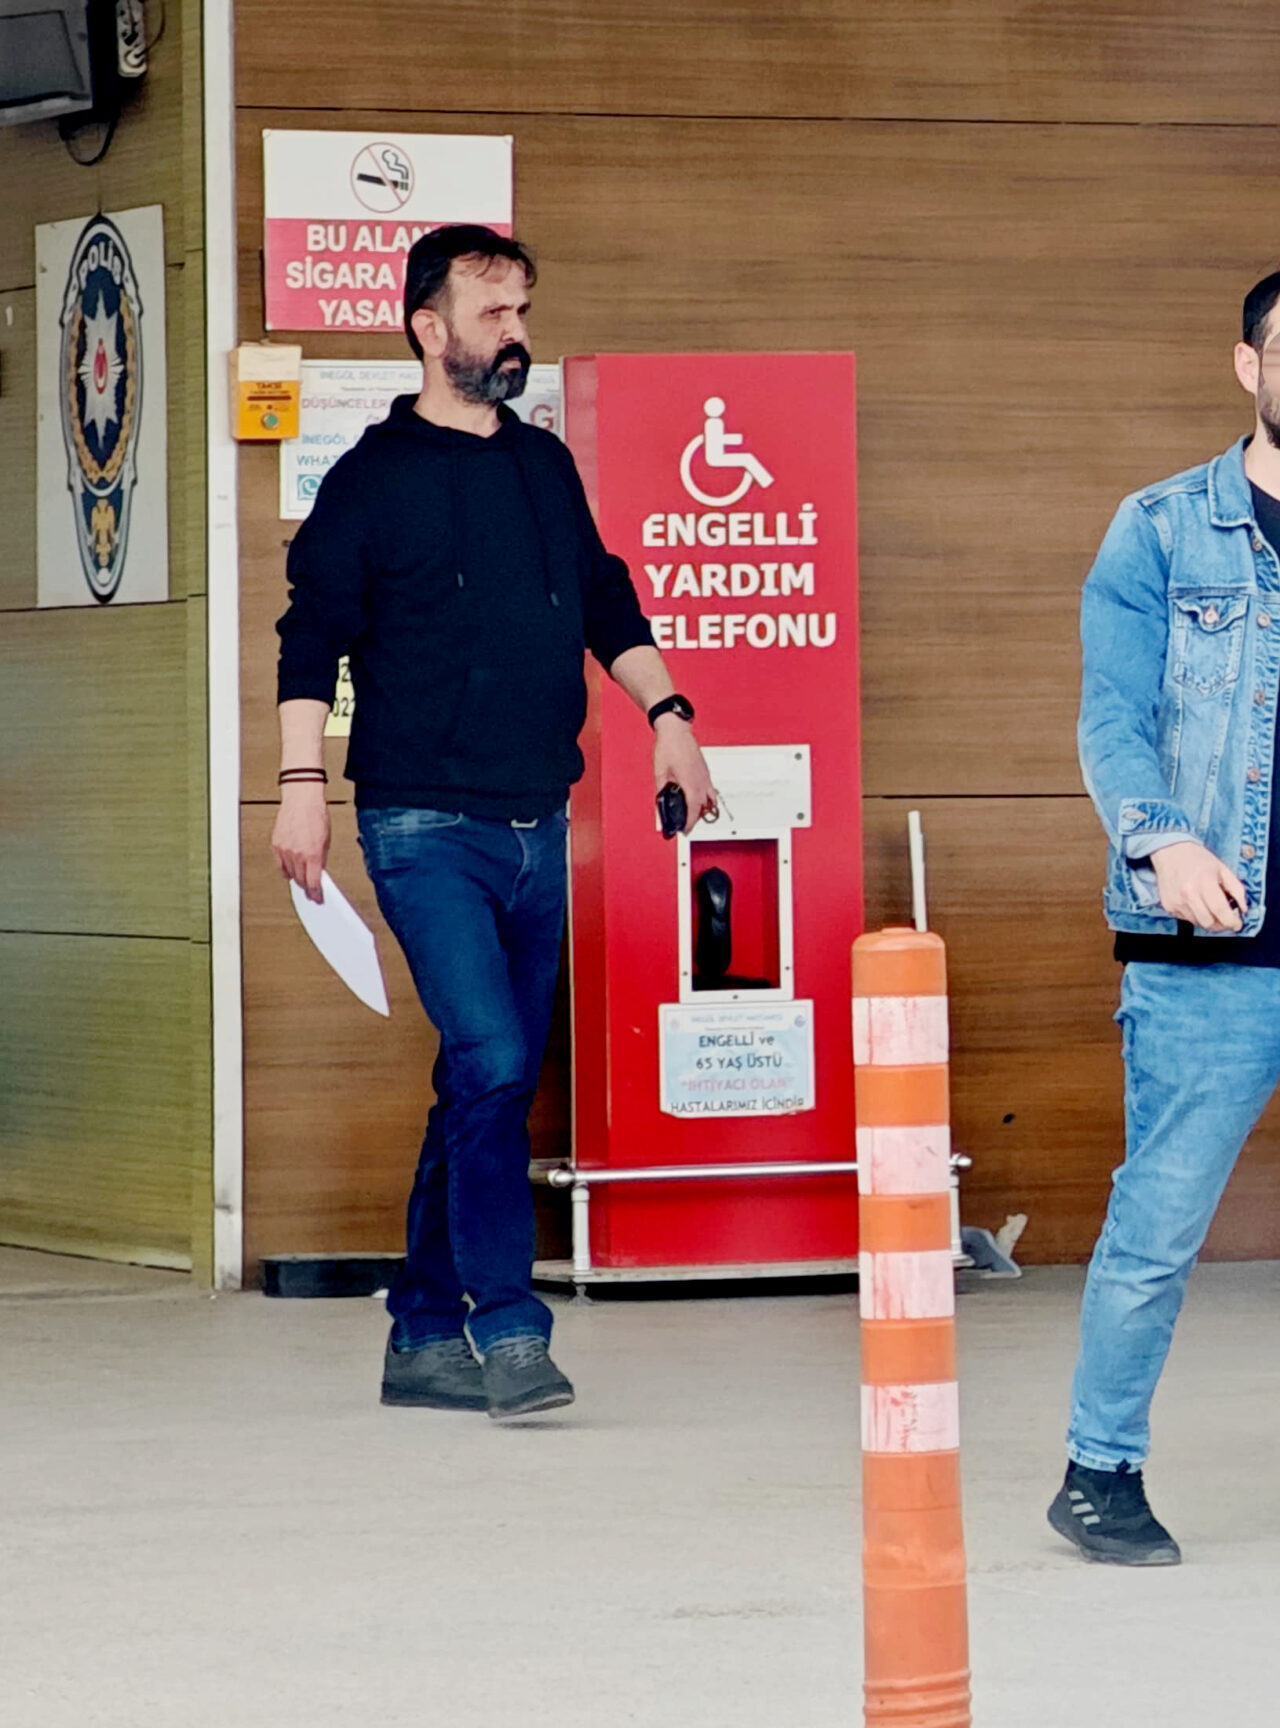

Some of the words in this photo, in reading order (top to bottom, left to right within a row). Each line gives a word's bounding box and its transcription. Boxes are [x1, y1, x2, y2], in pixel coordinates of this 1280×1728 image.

[306, 224, 347, 252] BU
[286, 256, 397, 290] SİGARA
[642, 503, 818, 547] ENGELLİ
[643, 563, 814, 598] YARDIM
[650, 612, 837, 650] ELEFONU
[698, 1032, 755, 1048] ENGELLİ
[759, 1035, 775, 1046] ve
[696, 1057, 713, 1070] 65
[717, 1056, 743, 1071] YAŞ
[747, 1052, 783, 1068] ÜSTÜ
[671, 1098, 758, 1113] HASTALARIMIZ
